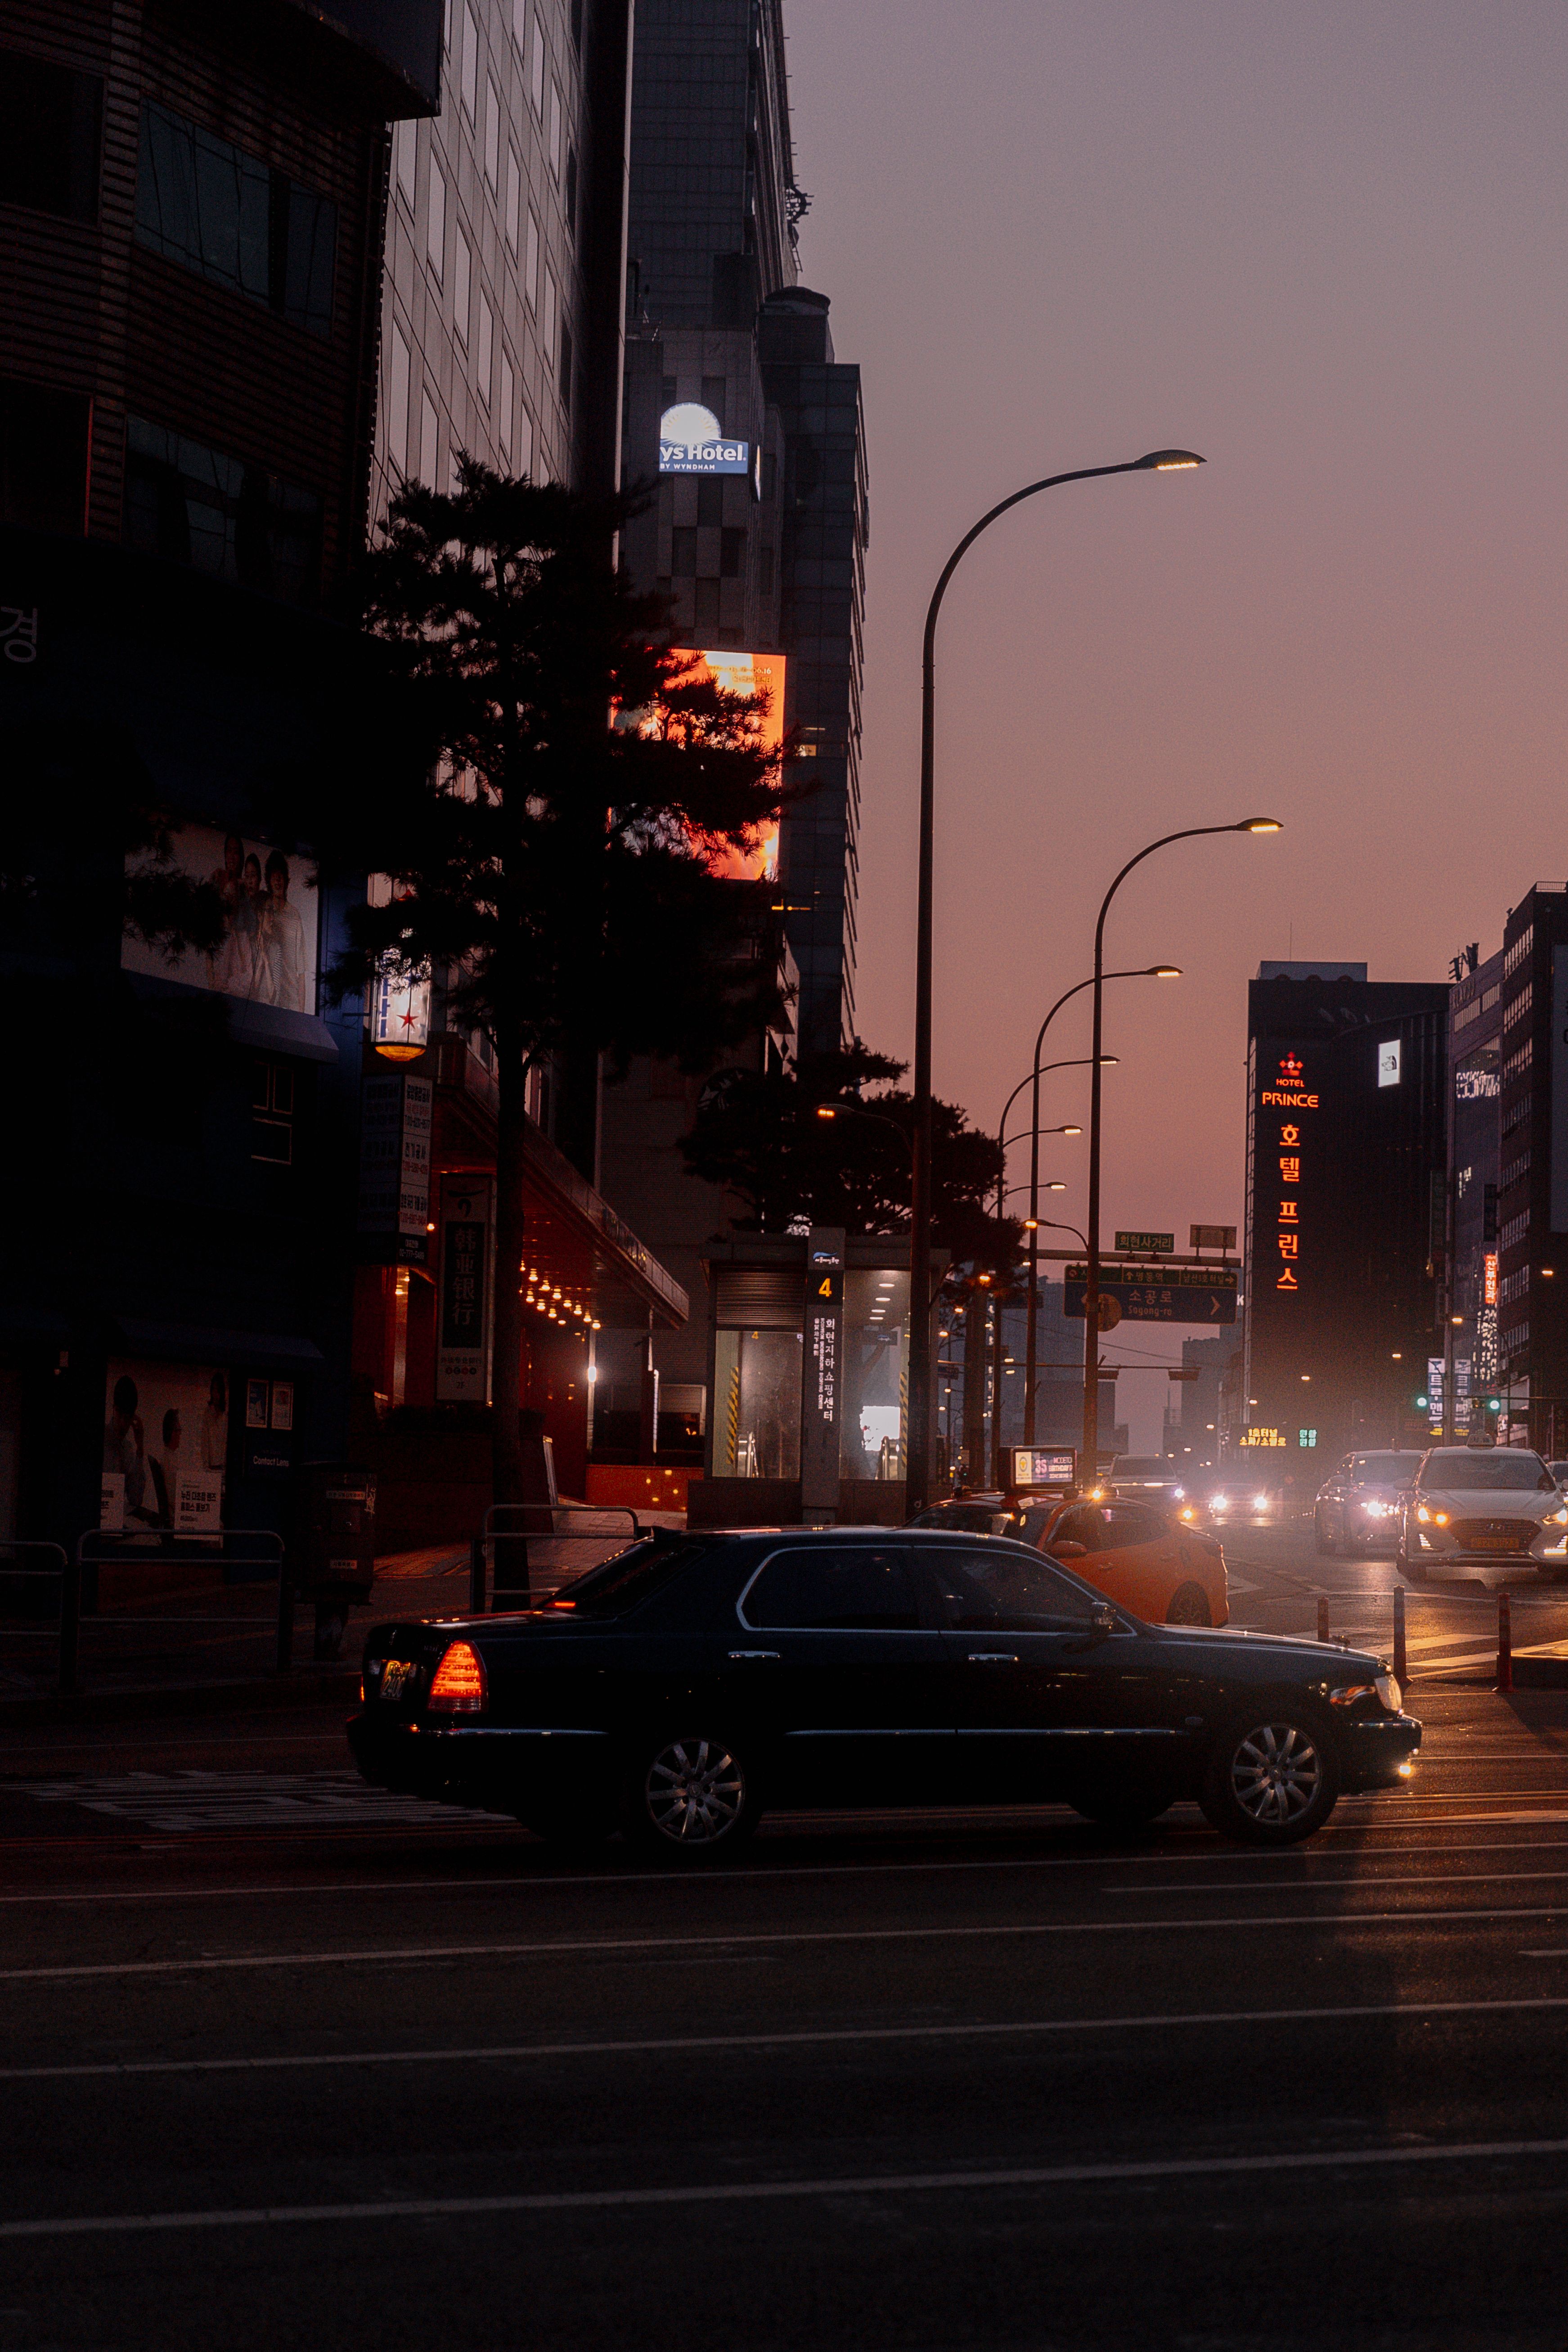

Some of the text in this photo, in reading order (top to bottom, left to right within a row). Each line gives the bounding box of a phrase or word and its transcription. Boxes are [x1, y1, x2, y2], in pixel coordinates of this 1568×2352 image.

[660, 446, 684, 462] ys
[0, 605, 39, 663] 경
[1276, 1079, 1305, 1088] HOTEL
[1262, 1092, 1319, 1108] PRINCE
[1277, 1123, 1301, 1291] 호텔 프린스
[1119, 1234, 1172, 1249] 회현사거리
[452, 1227, 478, 1326] 韩亚银行
[1135, 1272, 1164, 1282] 명동역
[1486, 1259, 1496, 1300] 산부인과
[818, 1277, 832, 1298] 4
[1128, 1289, 1173, 1304] 소공로
[1128, 1305, 1173, 1317] Sogong-ro
[823, 1318, 835, 1422] 회현지하쇼핑센터
[253, 1455, 289, 1467] Contact Lens
[1035, 1459, 1047, 1475] 35
